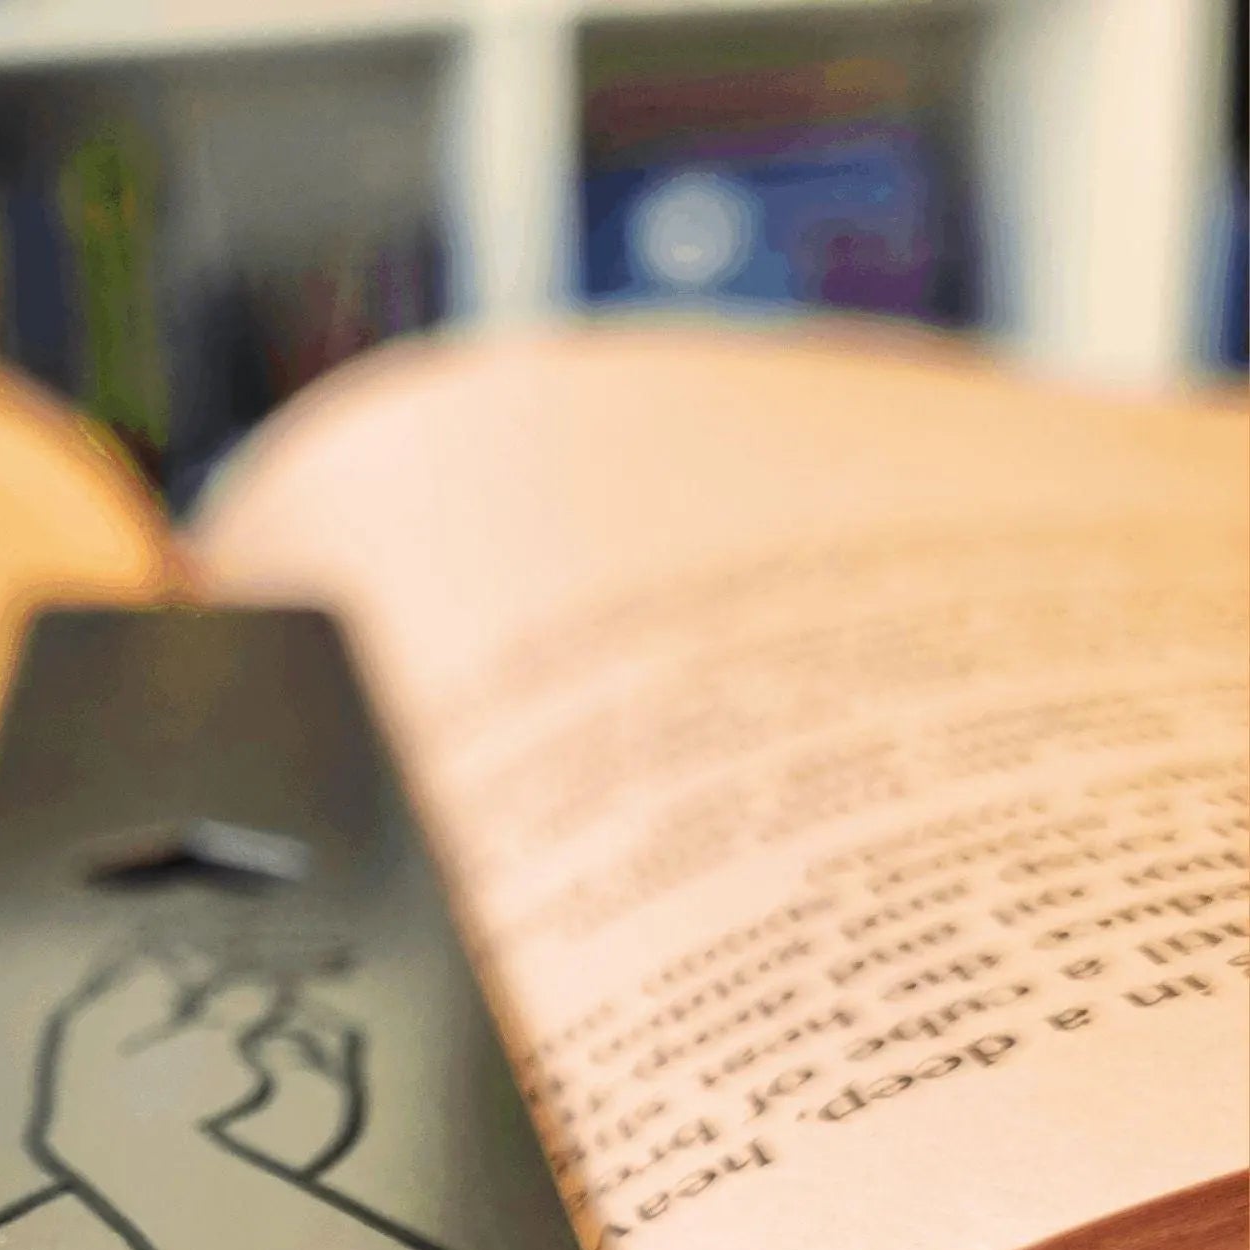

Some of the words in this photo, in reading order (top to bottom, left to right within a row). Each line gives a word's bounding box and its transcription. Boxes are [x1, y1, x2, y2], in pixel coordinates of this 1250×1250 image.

[1059, 956, 1108, 982] a
[1116, 972, 1214, 1009] in
[844, 982, 1034, 1062] cube
[1048, 1006, 1092, 1032] a
[746, 1064, 816, 1120] of
